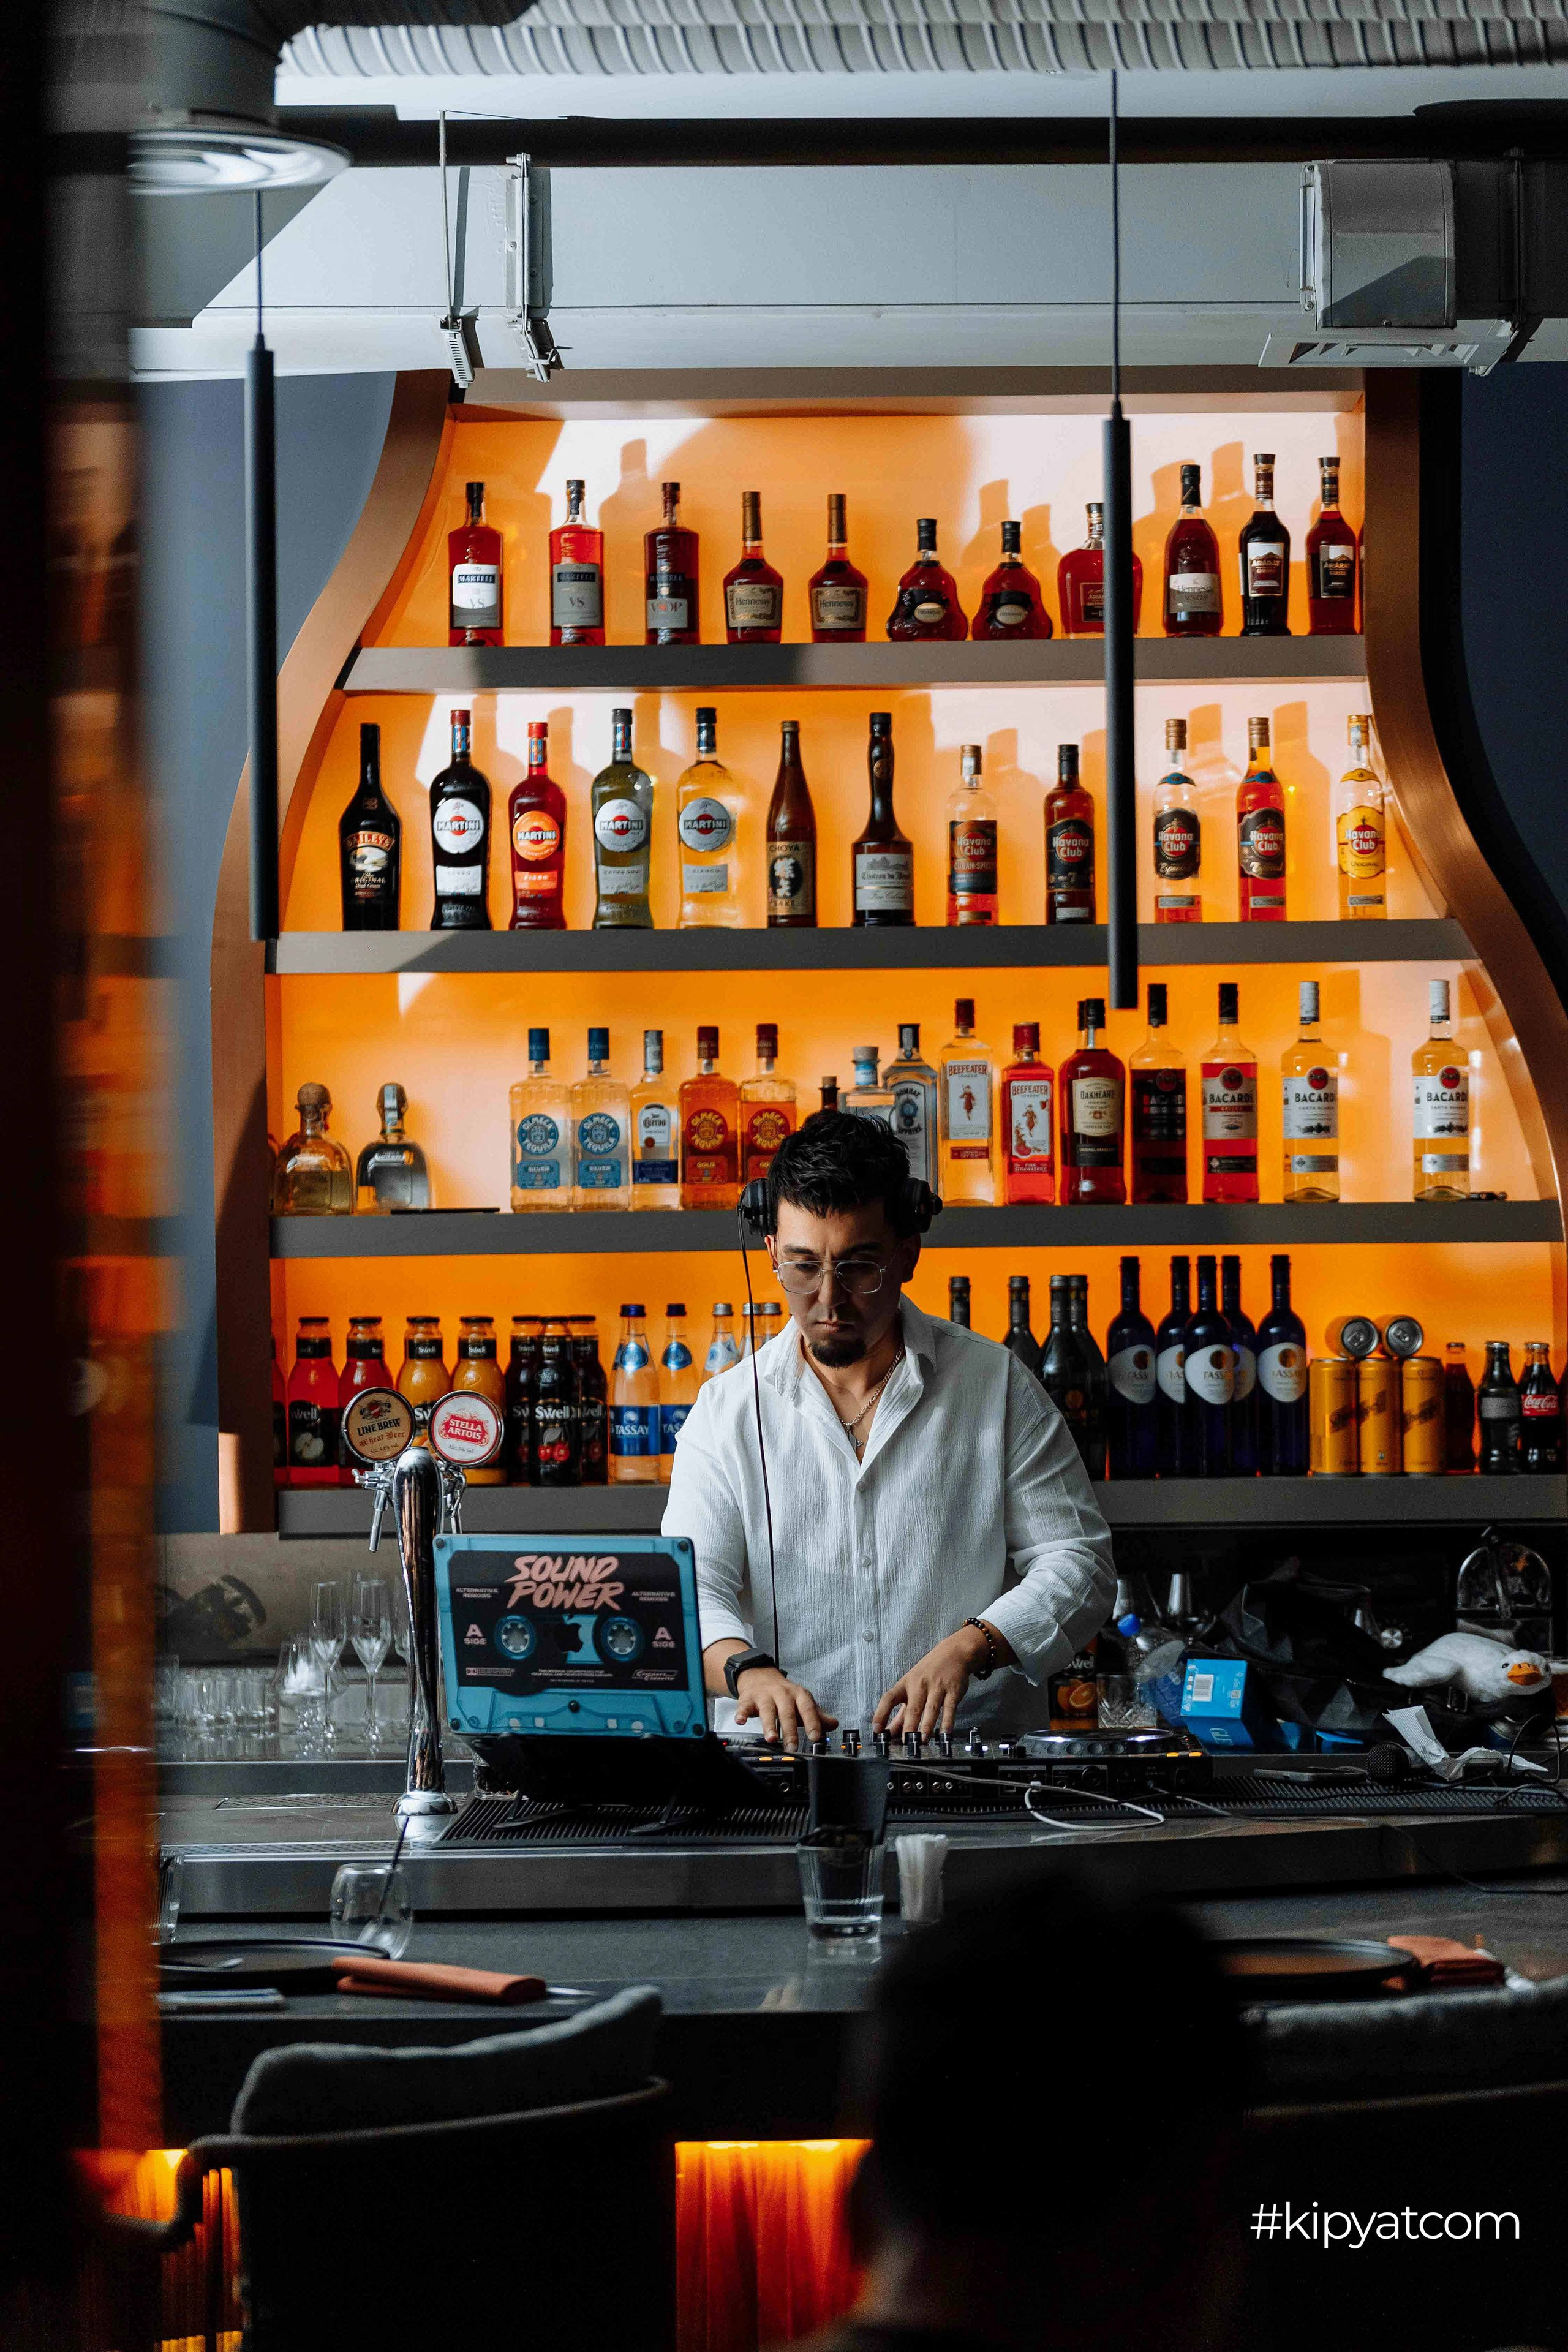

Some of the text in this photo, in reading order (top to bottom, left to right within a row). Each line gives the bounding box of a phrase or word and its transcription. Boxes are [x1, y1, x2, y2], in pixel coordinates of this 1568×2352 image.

[568, 597, 584, 607] VS
[437, 821, 481, 831] MARTINI
[600, 821, 643, 831] MARTINI
[683, 820, 729, 829] MARTINI
[518, 831, 557, 839] MARTINI
[1158, 831, 1193, 840] Havana
[1250, 831, 1284, 840] Havana
[1346, 830, 1382, 839] Havana
[1053, 838, 1089, 847] Havana
[1165, 842, 1186, 851] Club
[1257, 841, 1278, 850] Club
[1352, 839, 1376, 850] Club
[964, 846, 984, 855] Club
[1060, 847, 1082, 856] Club
[948, 1065, 987, 1076] BEEFEATER
[1012, 1085, 1048, 1096] BEEFEATER
[535, 1404, 570, 1420] Swell
[357, 1418, 400, 1437] LINE BREW
[449, 1419, 482, 1431] STELLA
[615, 1424, 649, 1435] TASSAY
[386, 1431, 405, 1441] Beer
[448, 1427, 481, 1440] ARTOIS
[504, 1555, 620, 1583] SOUND
[507, 1581, 625, 1611] POWER
[466, 1624, 484, 1637] A
[654, 1627, 673, 1640] A
